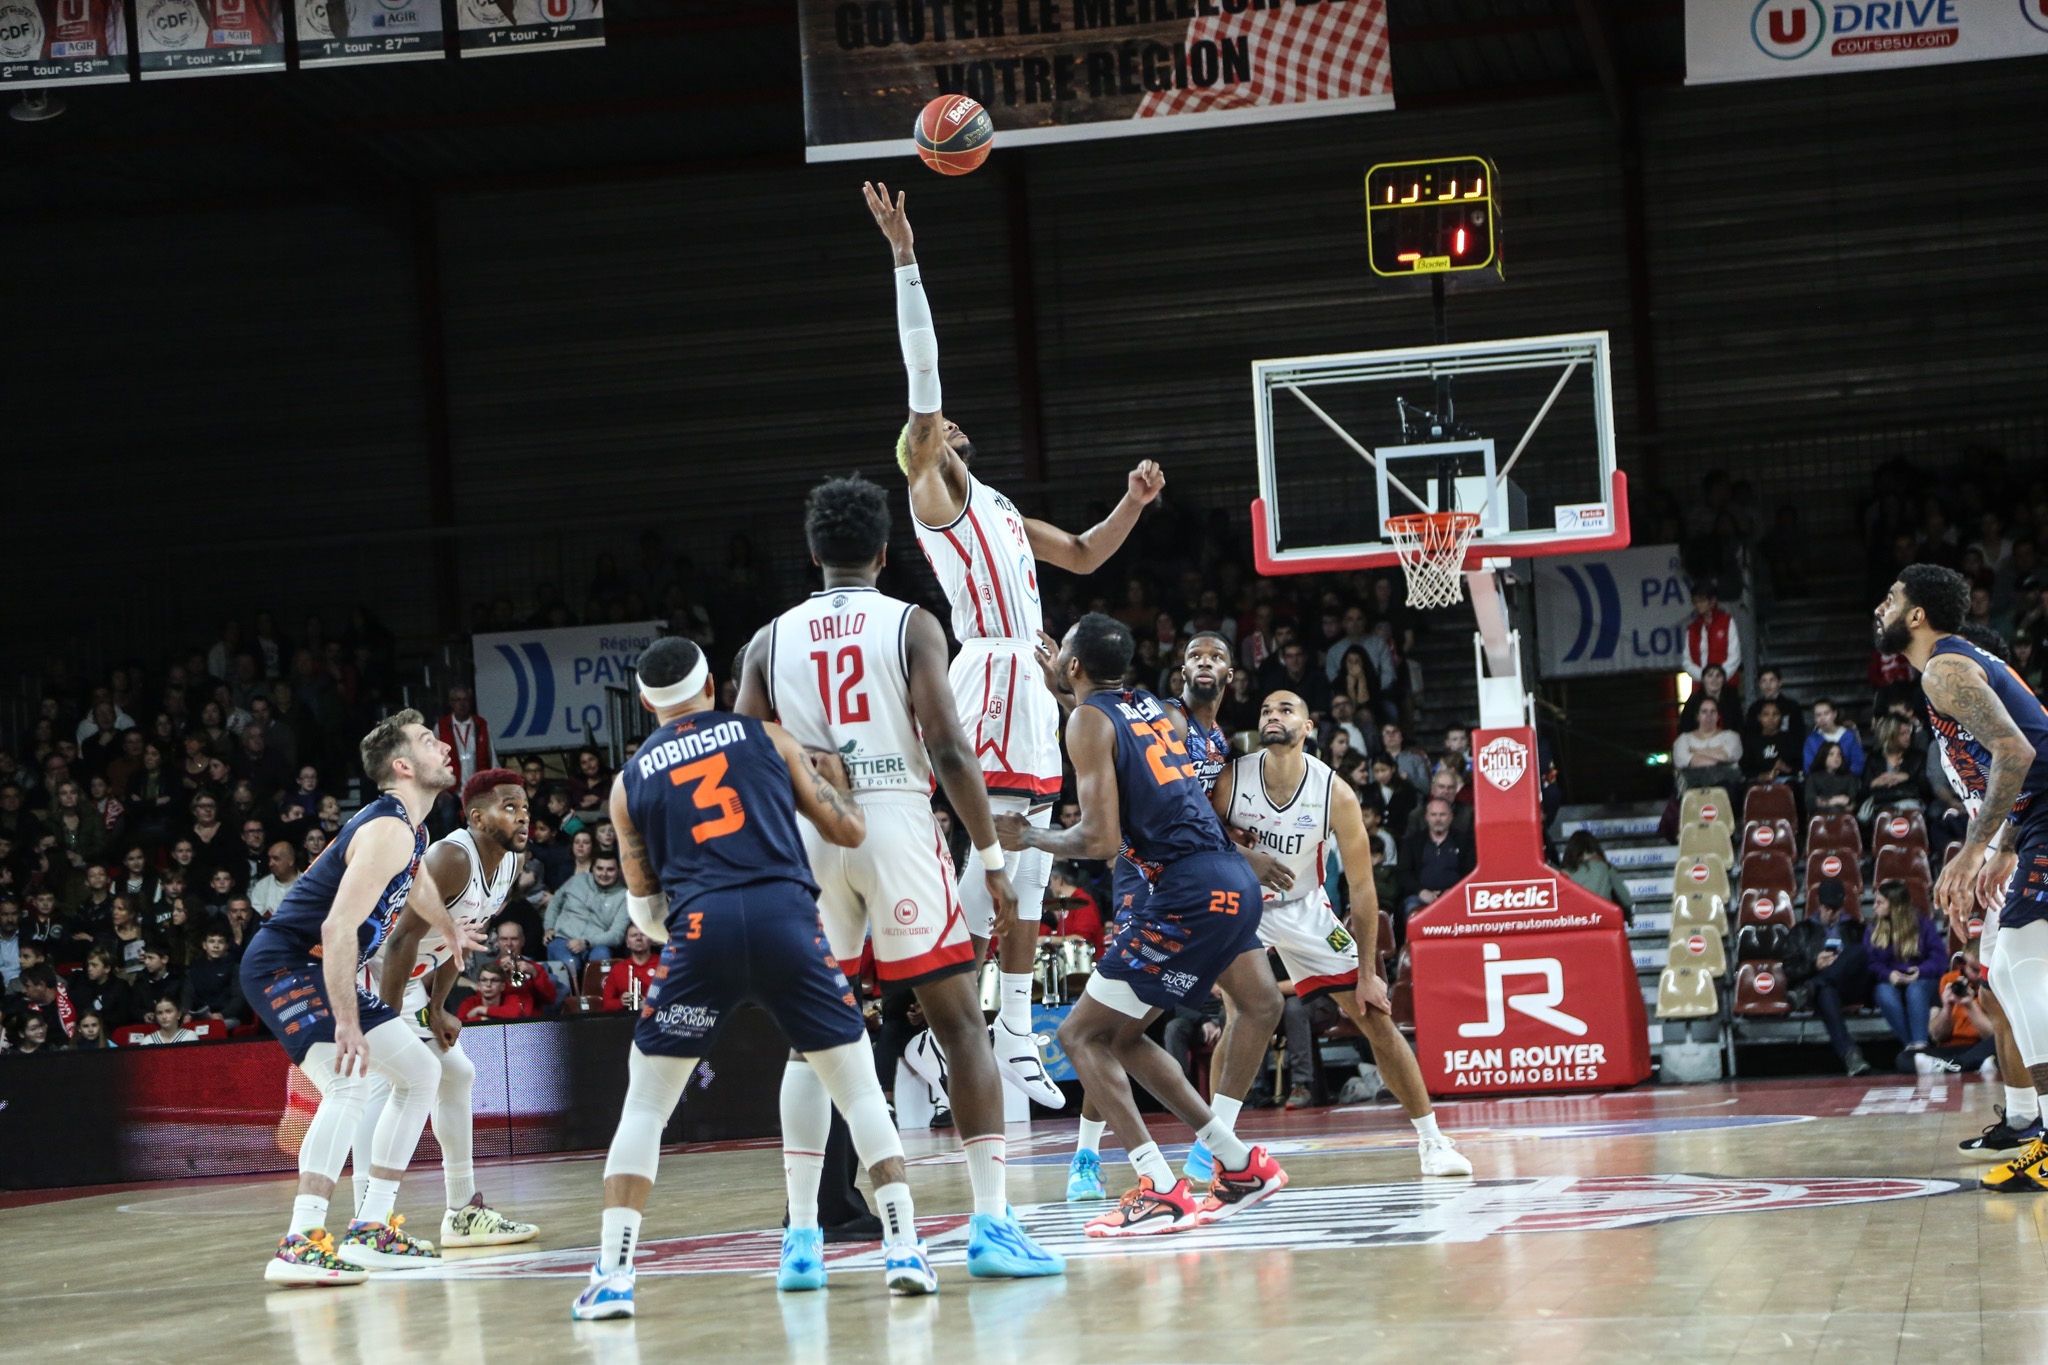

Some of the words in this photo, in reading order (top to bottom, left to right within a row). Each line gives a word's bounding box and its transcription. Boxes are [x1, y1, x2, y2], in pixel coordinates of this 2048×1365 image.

[157, 12, 188, 30] CDF
[388, 12, 416, 22] AGIR
[1769, 9, 1806, 45] U
[1832, 0, 1959, 34] DRIVE
[0, 23, 30, 40] CDF
[227, 31, 251, 40] AGIR
[510, 30, 539, 41] tour
[1838, 31, 1950, 54] coursesu.com
[69, 41, 95, 51] AGIR
[344, 42, 373, 53] tour
[32, 65, 61, 76] tour
[186, 54, 215, 65] tour
[1086, 37, 1251, 99] REGION
[809, 613, 867, 642] DALLO
[600, 637, 650, 652] Région
[810, 645, 871, 726] 12
[990, 701, 1003, 715] CB
[638, 720, 747, 780] ROBINSON
[1130, 717, 1197, 786] 25
[1478, 750, 1529, 773] CHOLET
[669, 751, 746, 845] 3
[1638, 853, 1664, 863] LOIRE
[1209, 890, 1240, 915] 25
[1474, 886, 1550, 910] Betclic
[686, 912, 704, 940] 3
[1422, 912, 1602, 936] www.jeanrouyerautomobiles.fr
[655, 1011, 717, 1028] DUCARDIN
[1444, 1048, 1503, 1074] JEAN
[1510, 1043, 1607, 1069] ROUYER
[1455, 1065, 1598, 1087] AUTOMOBILES
